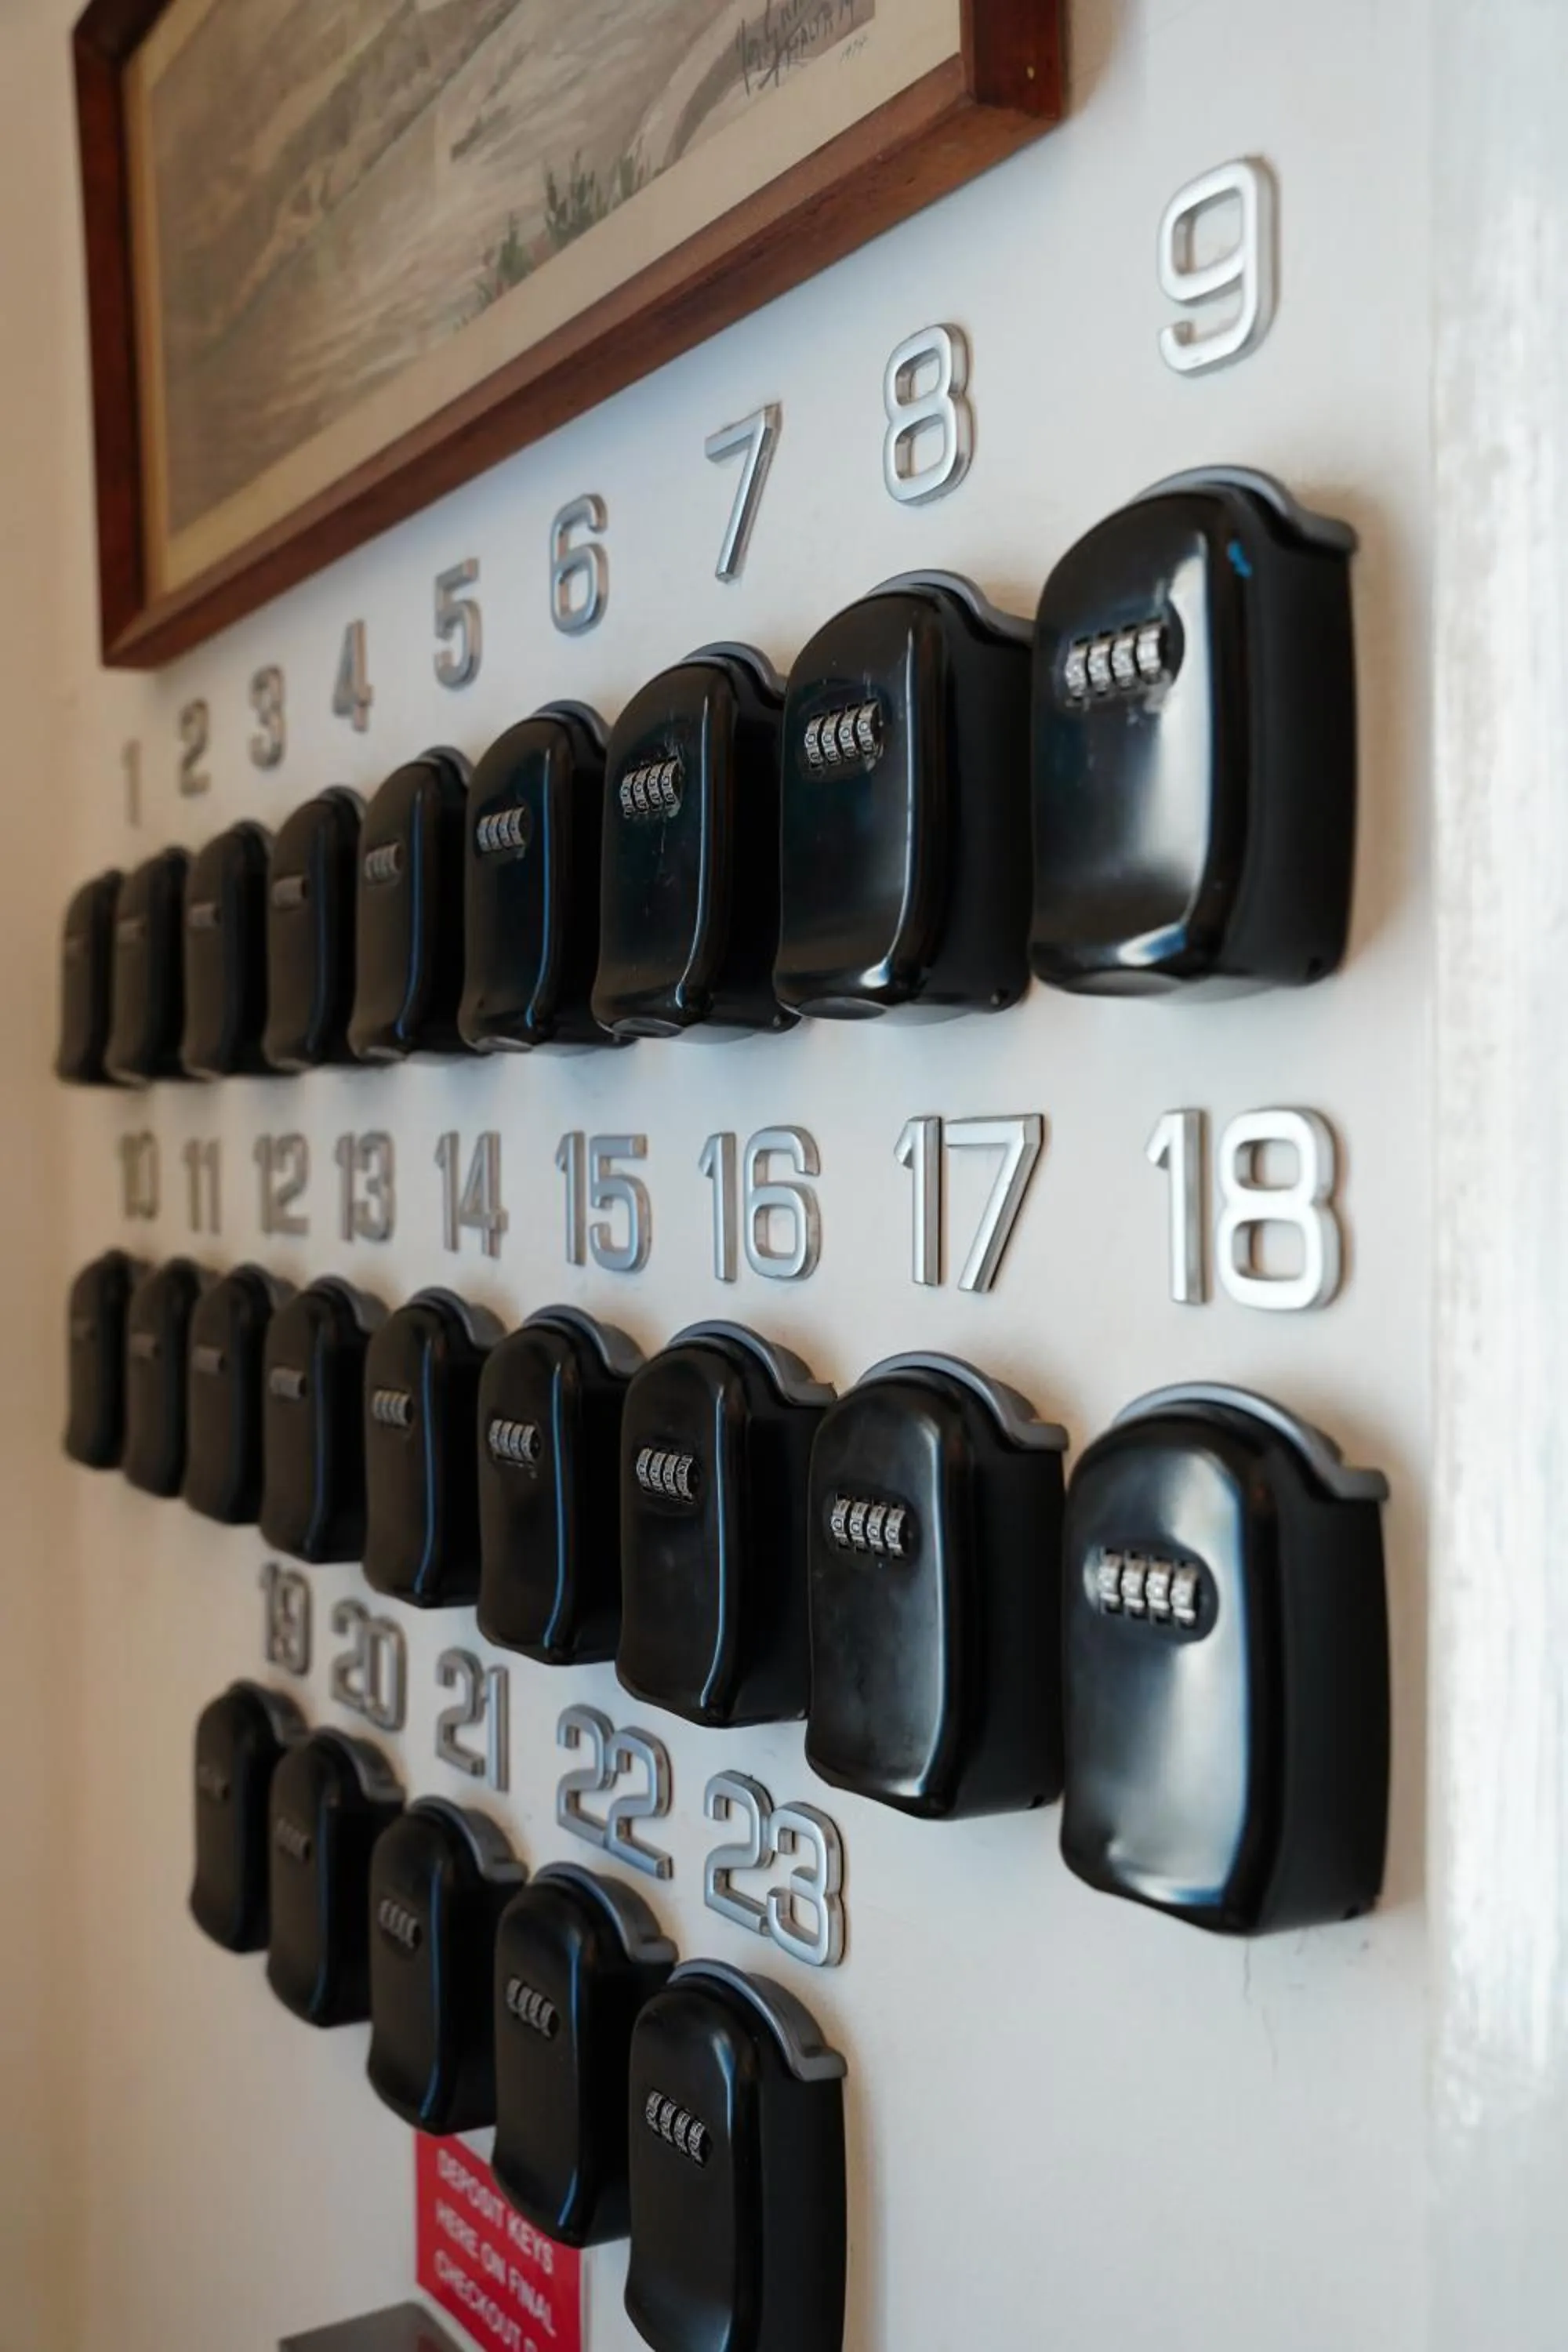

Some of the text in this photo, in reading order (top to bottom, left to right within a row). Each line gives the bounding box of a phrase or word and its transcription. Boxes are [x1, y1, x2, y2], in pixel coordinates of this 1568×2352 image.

[1156, 154, 1279, 377] 9
[883, 322, 975, 506] 8
[704, 400, 782, 582] 7
[434, 557, 483, 690] 5
[547, 492, 609, 636] 6
[250, 663, 285, 771] 3
[332, 619, 373, 733] 4
[122, 739, 141, 828] 1
[178, 698, 210, 797] 2
[119, 1128, 162, 1221] 10
[182, 1135, 222, 1236] 11
[252, 1131, 310, 1238] 12
[334, 1130, 396, 1244] 13
[434, 1129, 509, 1259] 14
[553, 1130, 653, 1274] 15
[698, 1124, 822, 1283] 16
[891, 1112, 1044, 1294] 17
[1144, 1106, 1345, 1312] 18
[260, 1562, 312, 1677] 19
[330, 1595, 408, 1733] 20
[436, 1646, 509, 1793] 21
[556, 1703, 673, 1880] 22
[704, 1768, 849, 1968] 23
[435, 2198, 556, 2338] HERE ON FINAL
[507, 2210, 553, 2274] KEYS
